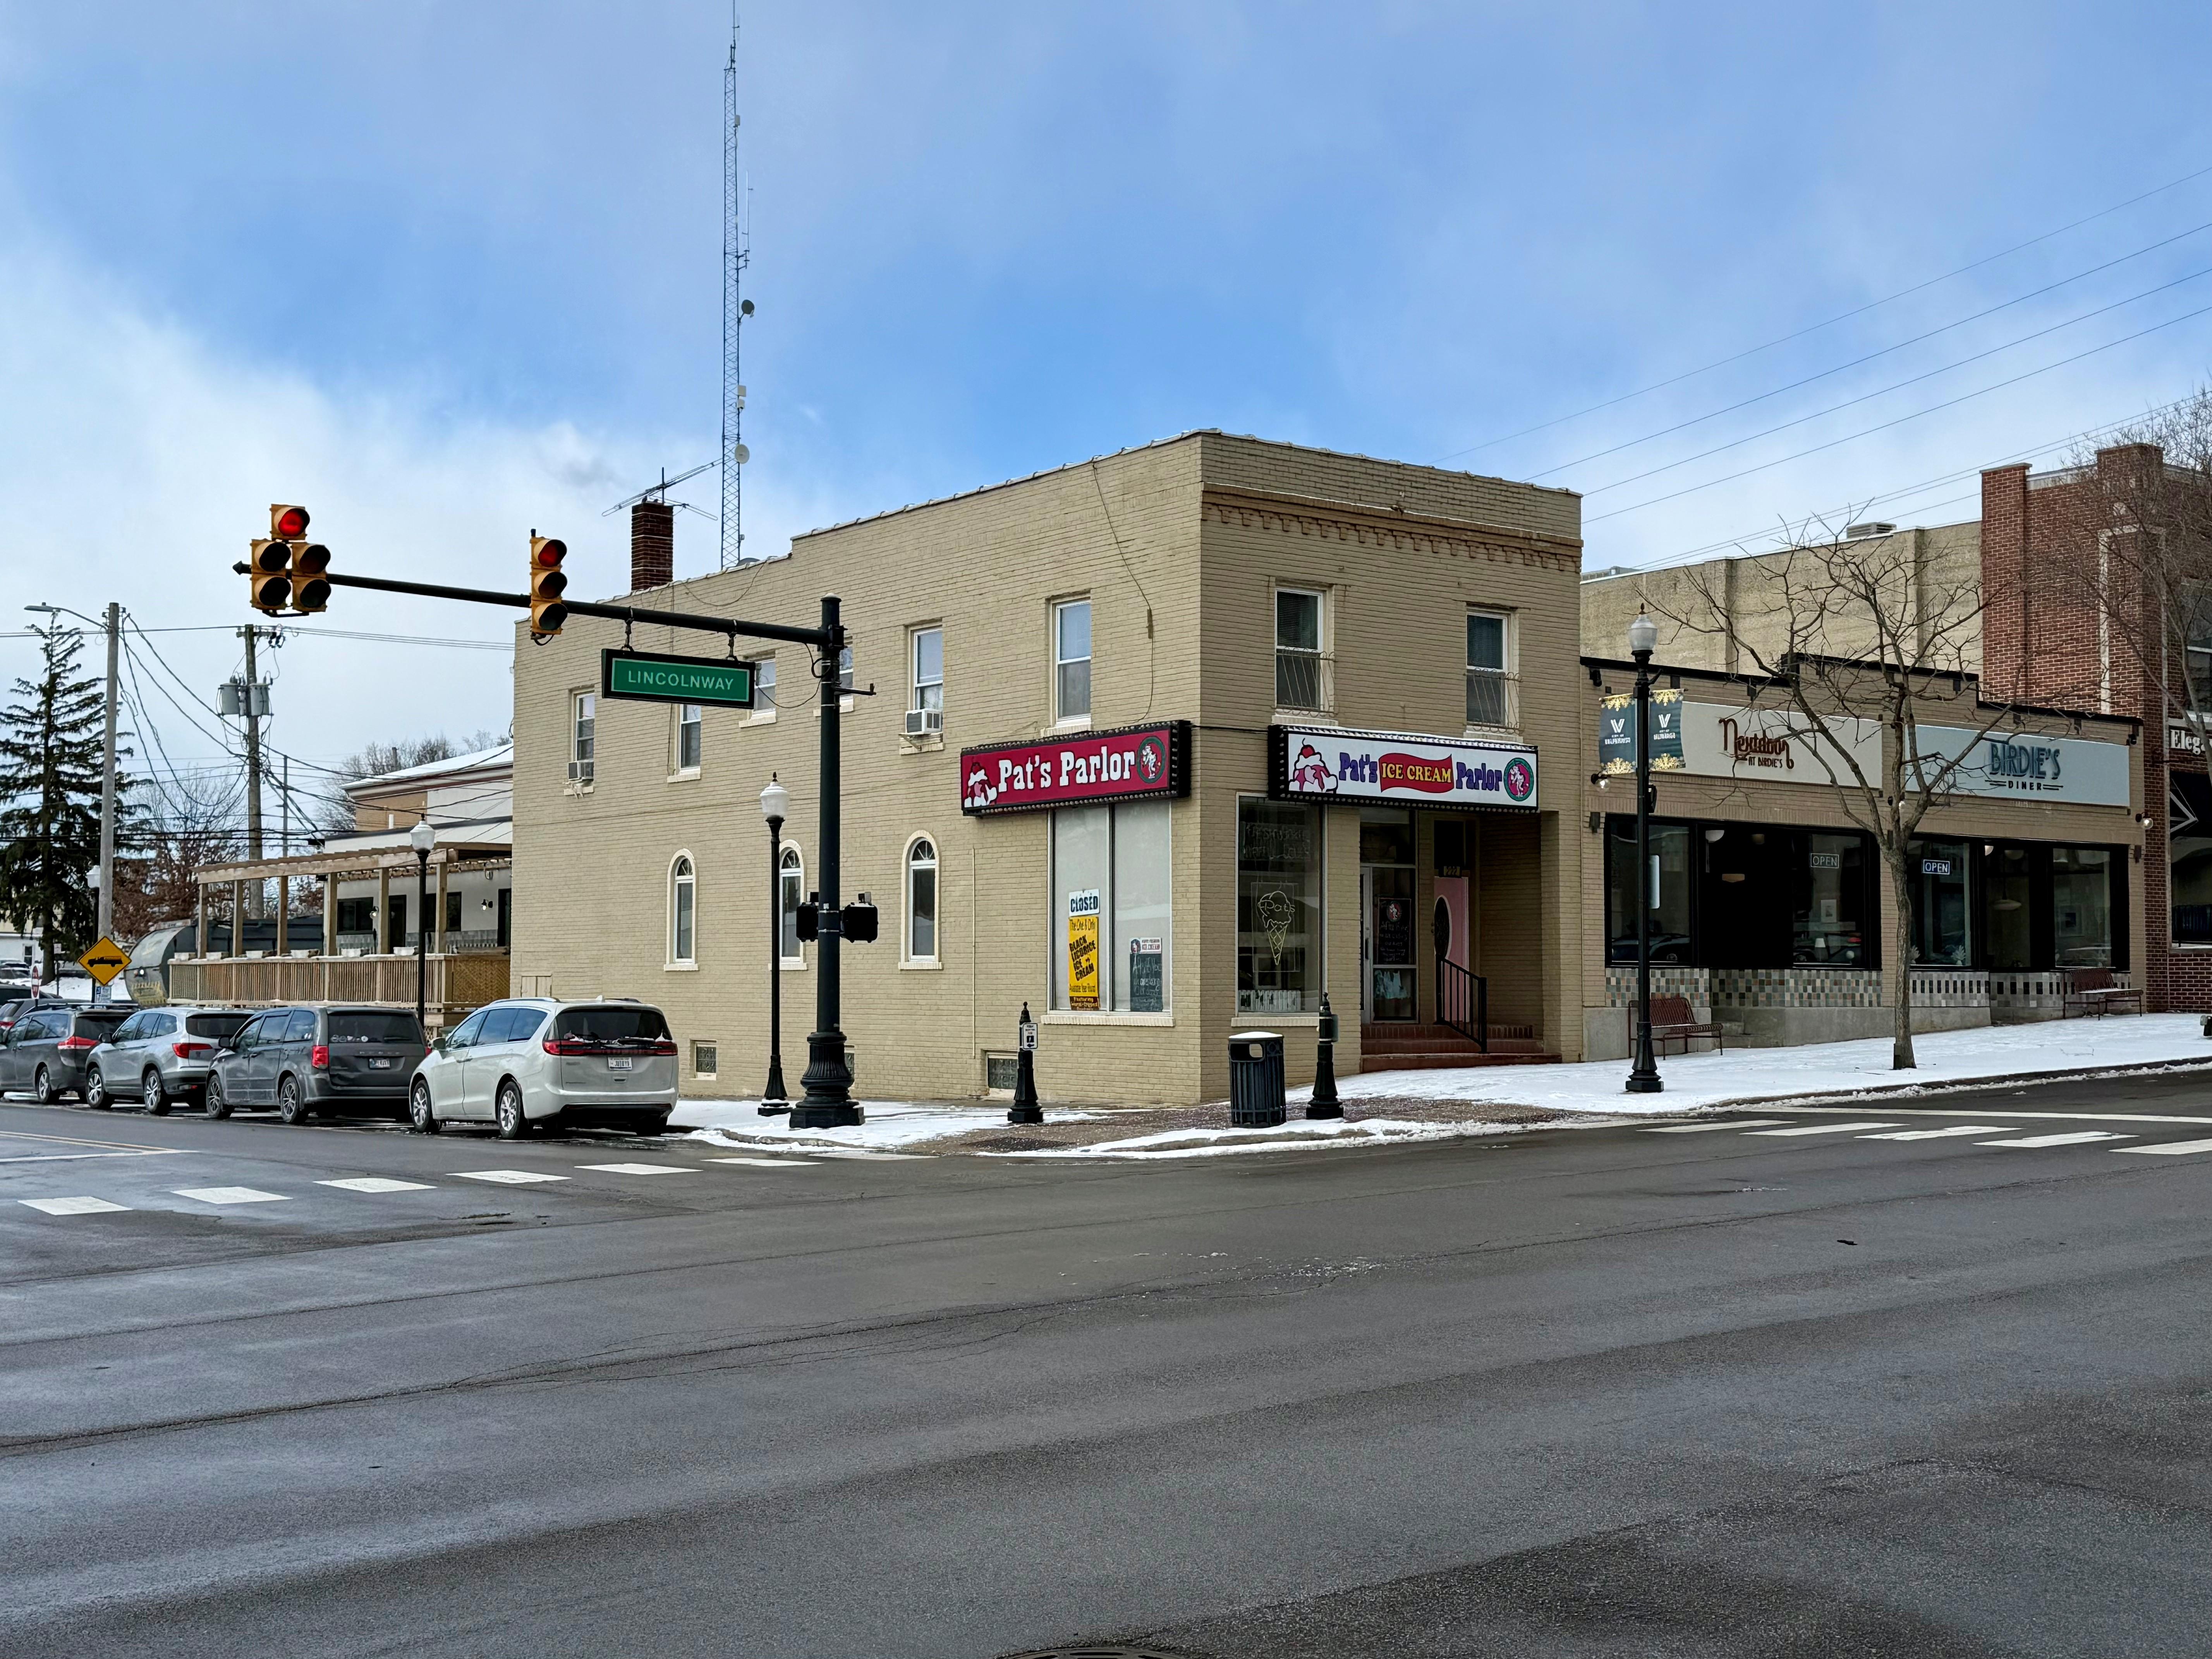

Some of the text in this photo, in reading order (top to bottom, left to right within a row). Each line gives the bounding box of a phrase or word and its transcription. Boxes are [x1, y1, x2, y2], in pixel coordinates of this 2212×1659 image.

[628, 670, 734, 690] LINCOLNWAY
[2170, 729, 2212, 755] Eleg
[998, 746, 1135, 792] Pat's Parlor
[1748, 756, 1783, 768] AT BIRDIE'S
[1990, 742, 2061, 779] BIRDIE'S
[1339, 752, 1503, 792] Pat's ICE CREAM Parlor
[2008, 780, 2042, 790] DINER
[1813, 856, 1837, 866] OPEN
[1925, 862, 1948, 872] OPEN
[1070, 896, 1098, 912] CLOSED
[1069, 934, 1087, 951] BLACK
[1072, 940, 1096, 962] LICORICE
[1073, 959, 1083, 971] ICE
[1075, 963, 1095, 981] CREAM
